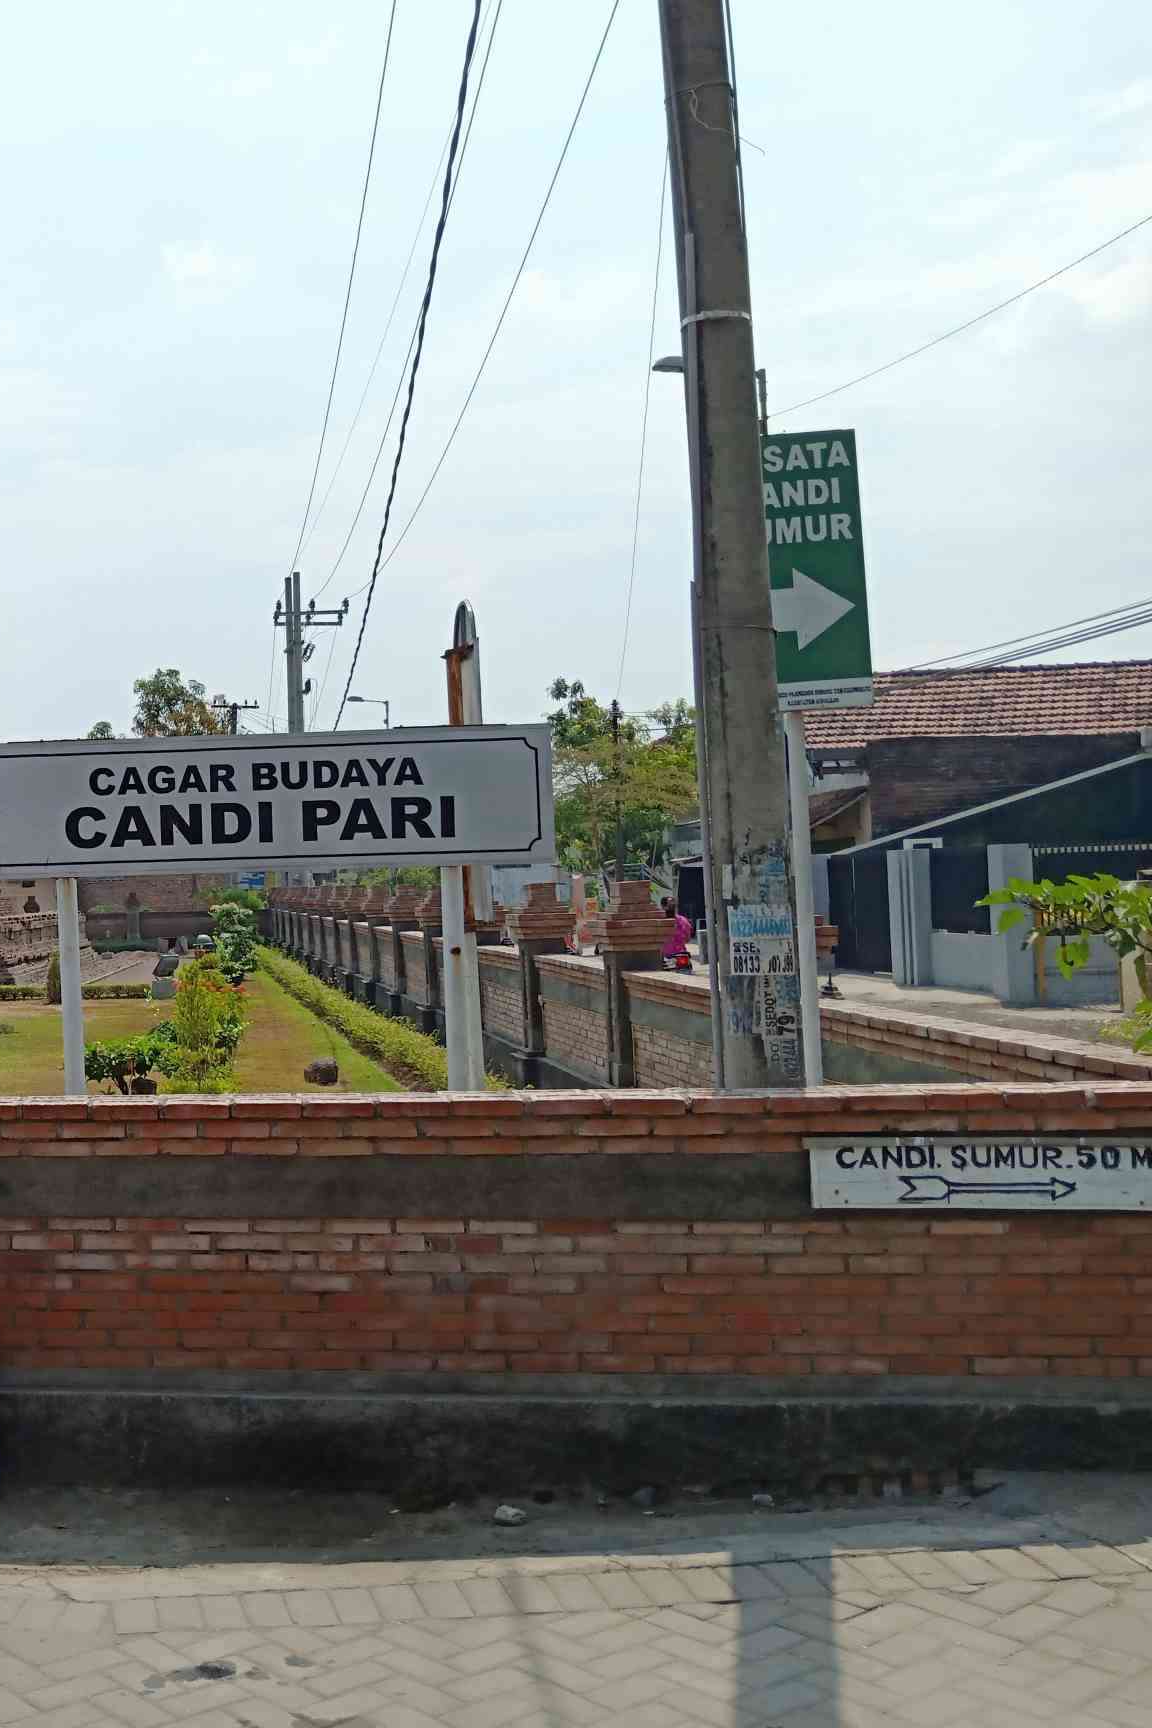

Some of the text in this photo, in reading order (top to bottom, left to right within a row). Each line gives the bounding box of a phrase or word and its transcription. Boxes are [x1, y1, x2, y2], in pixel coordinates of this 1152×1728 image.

[763, 440, 851, 473] SATA
[88, 757, 425, 796] CAGAR BUDAYA
[64, 795, 456, 849] CANDI PARI
[835, 1145, 942, 1169] CANDI.
